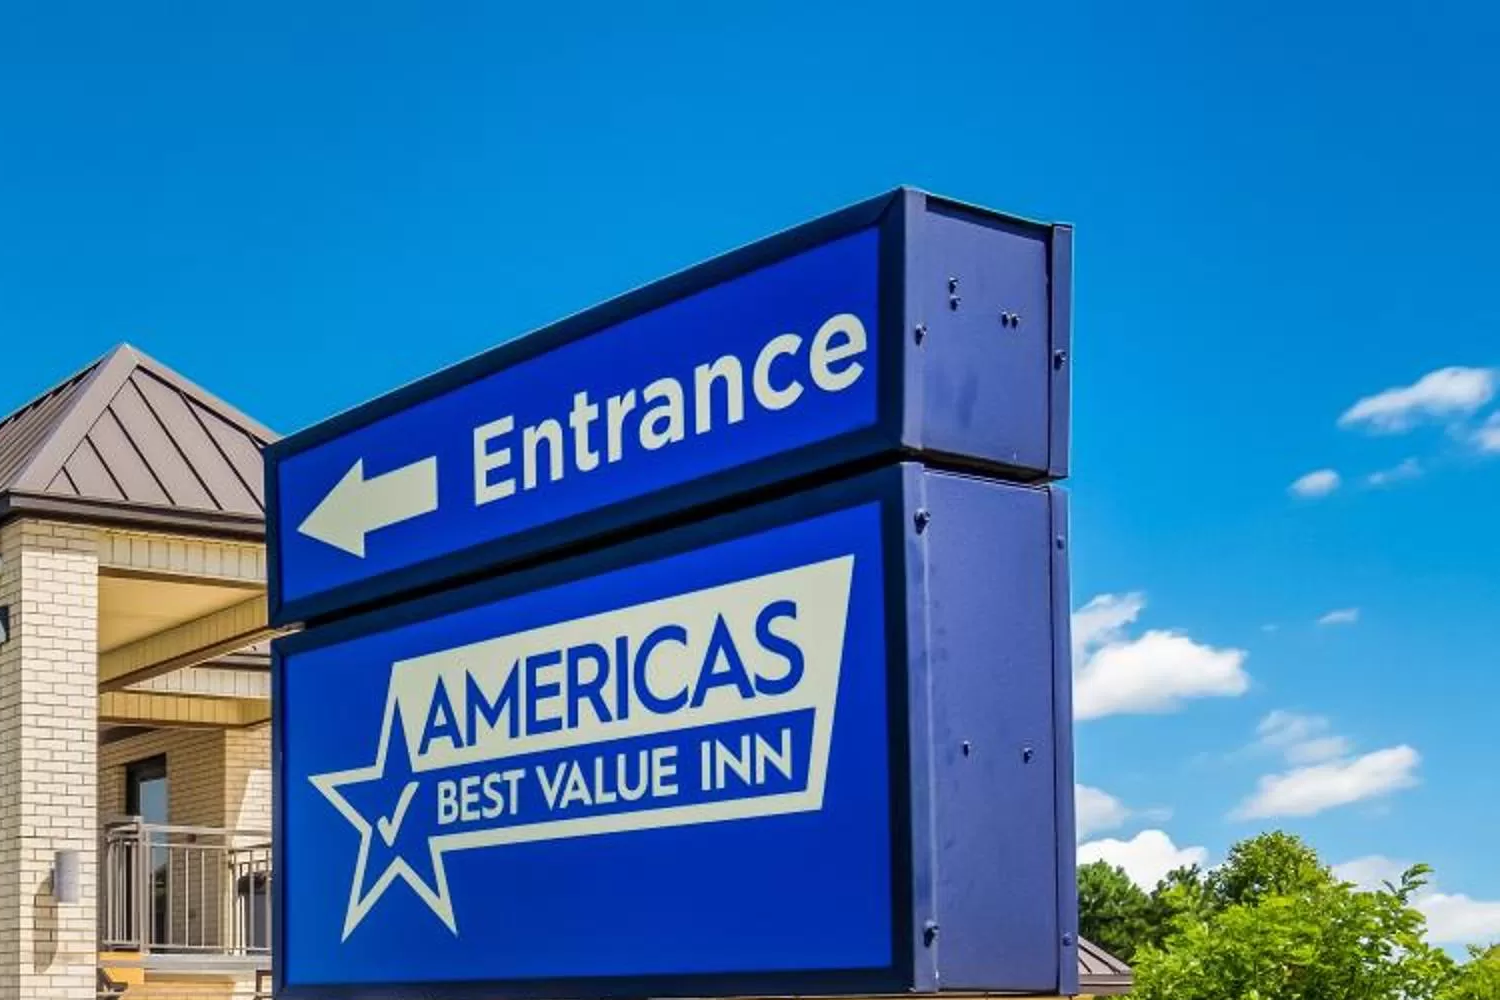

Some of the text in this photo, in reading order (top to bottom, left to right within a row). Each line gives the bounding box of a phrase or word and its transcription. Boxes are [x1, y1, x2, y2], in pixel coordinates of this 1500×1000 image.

[473, 313, 867, 505] Entrance
[417, 599, 806, 757] AMERICAS
[437, 729, 792, 825] BEST VALUE INN
